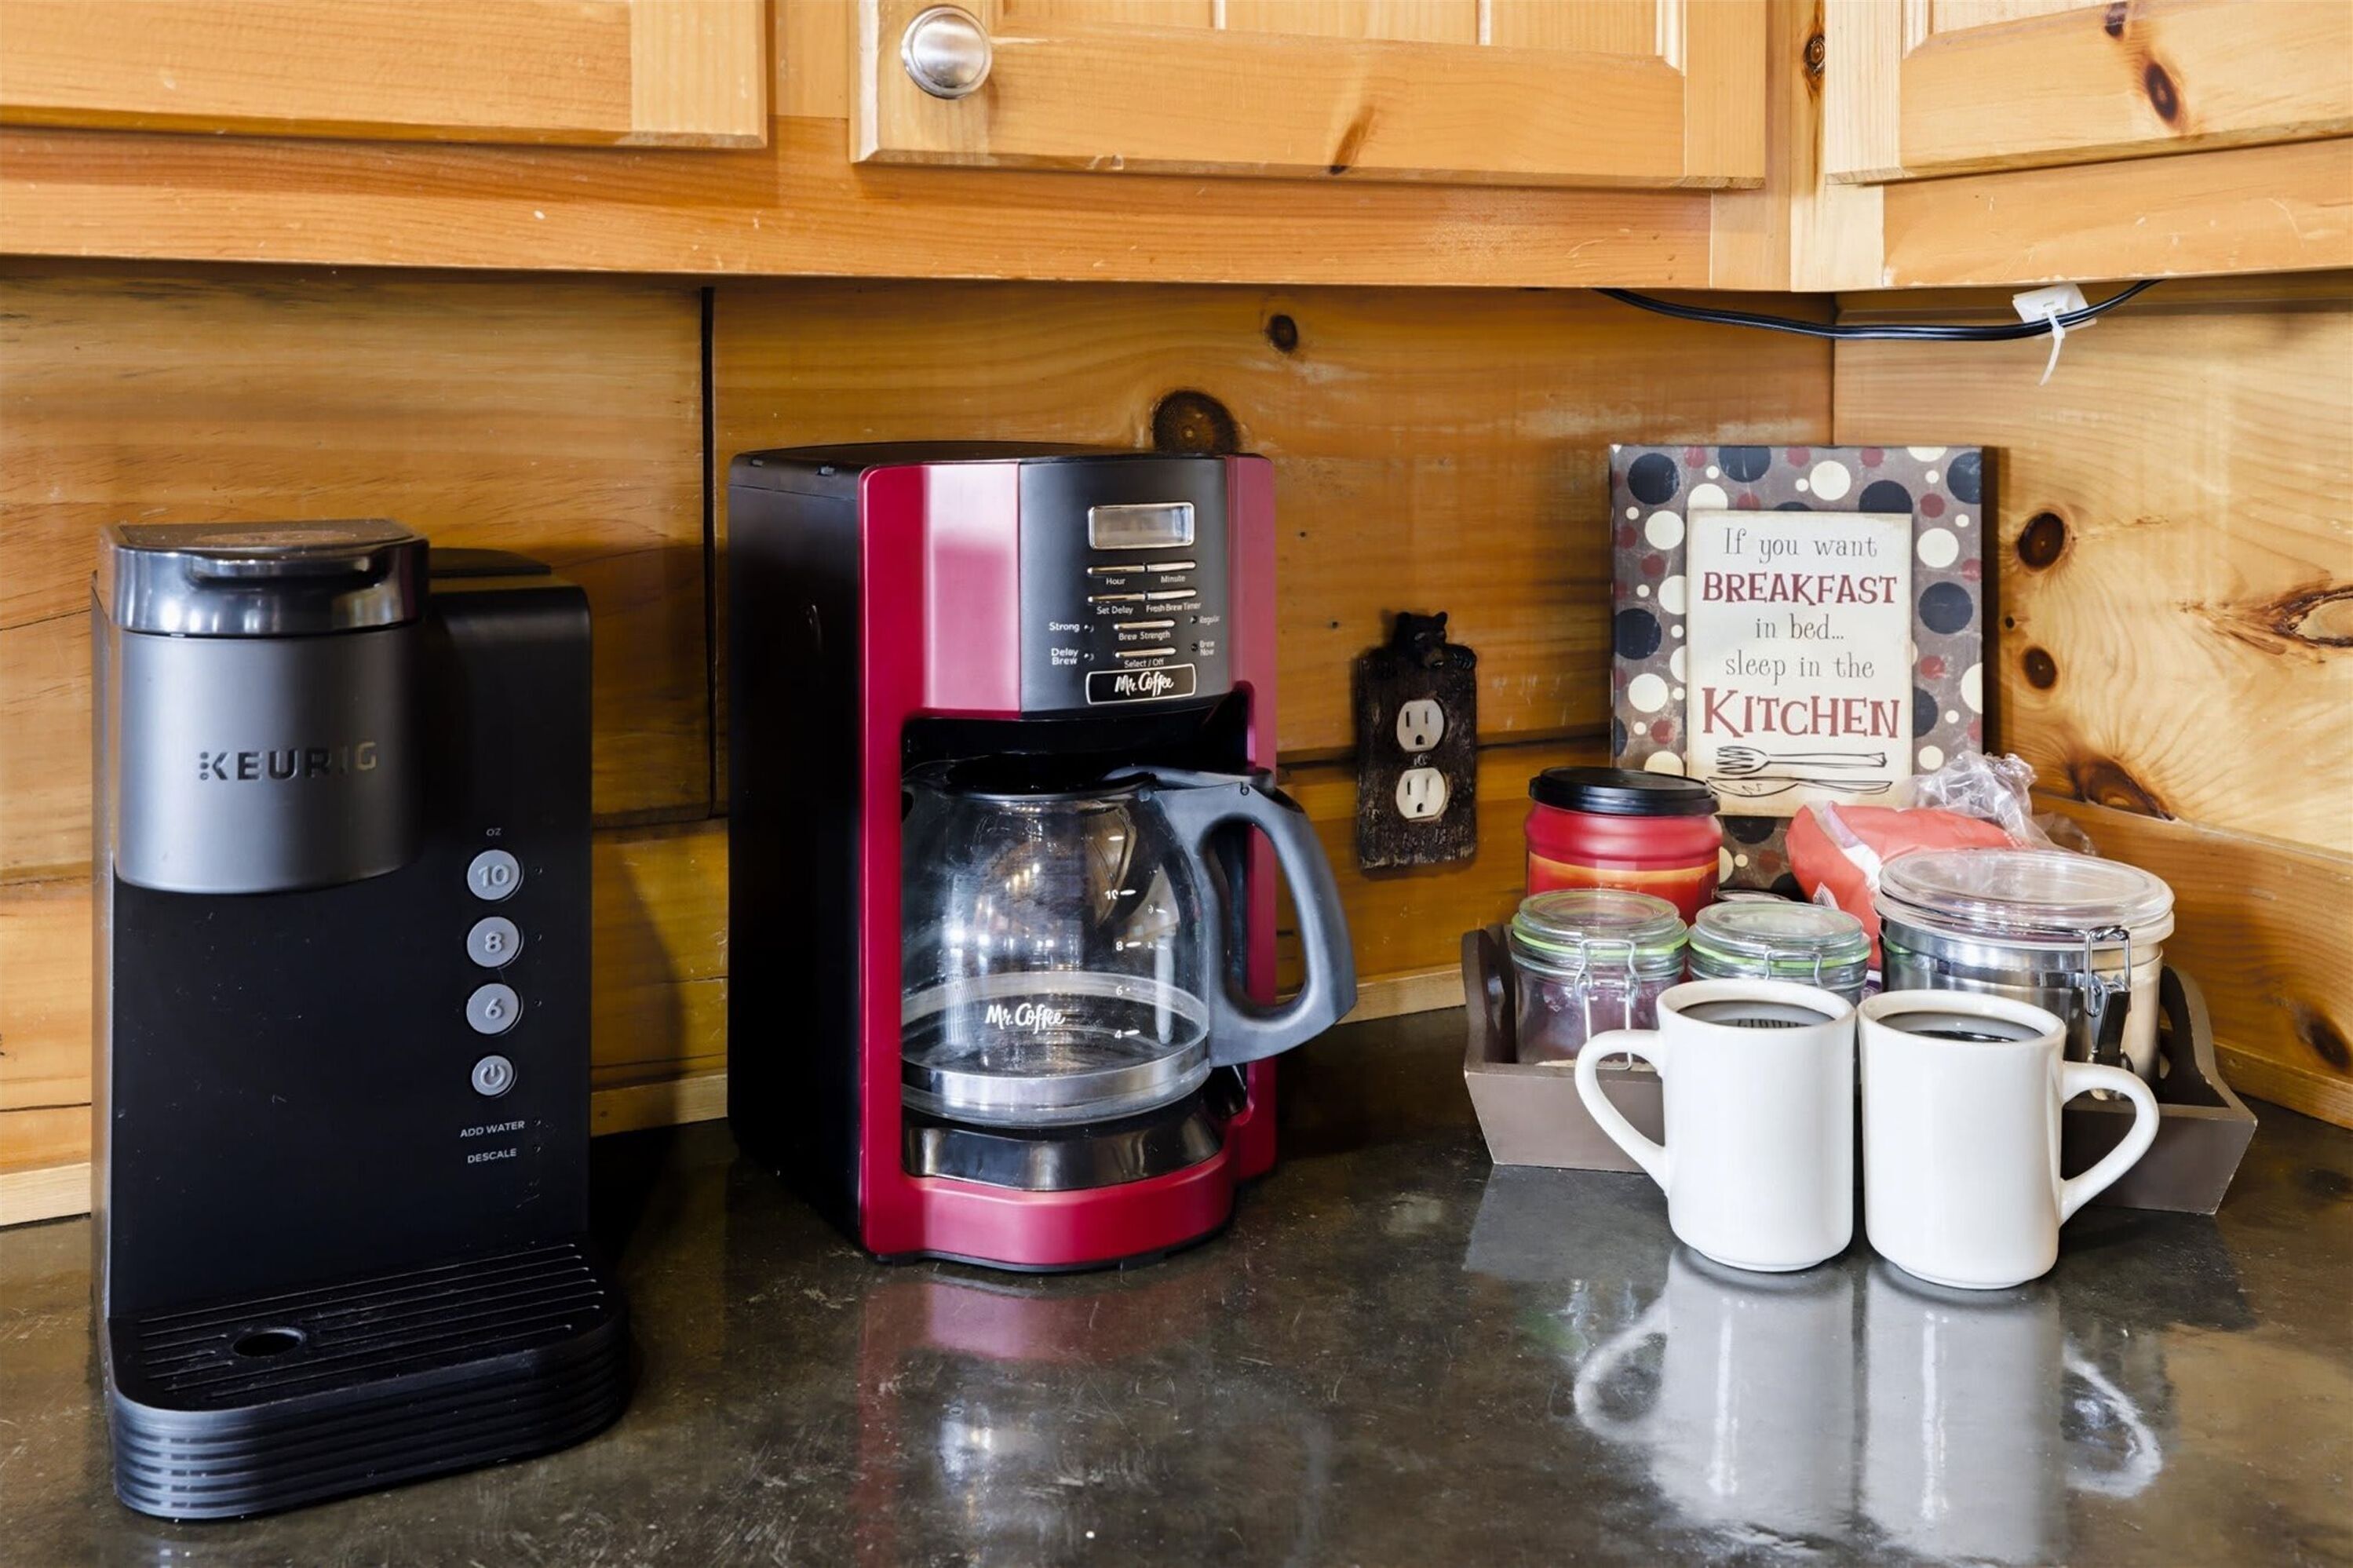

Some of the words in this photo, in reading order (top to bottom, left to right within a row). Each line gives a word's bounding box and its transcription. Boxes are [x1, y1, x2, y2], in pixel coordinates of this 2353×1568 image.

[1724, 527, 1747, 556] If
[1759, 539, 1798, 564] you
[1814, 536, 1878, 557] want
[1160, 574, 1187, 583] Minute
[1702, 571, 1898, 607] BREAKFAST
[1096, 606, 1111, 614] Set
[1111, 605, 1134, 616] Delay
[1146, 604, 1166, 613] Fresh
[1166, 603, 1183, 611] Brew
[1049, 622, 1080, 633] Strong
[1118, 633, 1138, 641] Brew
[1140, 630, 1171, 641] Strength
[1755, 617, 1777, 640] in
[1051, 647, 1079, 657] Delay
[1052, 657, 1078, 665] Brew
[1123, 660, 1147, 669] Select
[1152, 658, 1165, 666] Off
[1724, 649, 1786, 685] sleep
[1799, 656, 1821, 678] in
[1835, 652, 1875, 679] the
[1114, 674, 1137, 696] Mr.
[1138, 671, 1174, 697] Coffee
[1702, 687, 1900, 738] KITCHEN
[199, 742, 377, 781] KEURIG
[478, 865, 509, 887] 10
[1105, 889, 1118, 900] 10
[484, 930, 503, 955] 8
[1115, 941, 1124, 952] 8
[1115, 986, 1122, 997] 6
[484, 997, 503, 1021] 6
[985, 1004, 1013, 1030] Mr.
[1015, 1002, 1066, 1034] Coffee
[1114, 1030, 1122, 1040] 4
[460, 1126, 484, 1138] ADD
[486, 1120, 525, 1134] WATER
[467, 1147, 518, 1164] DESCALE
